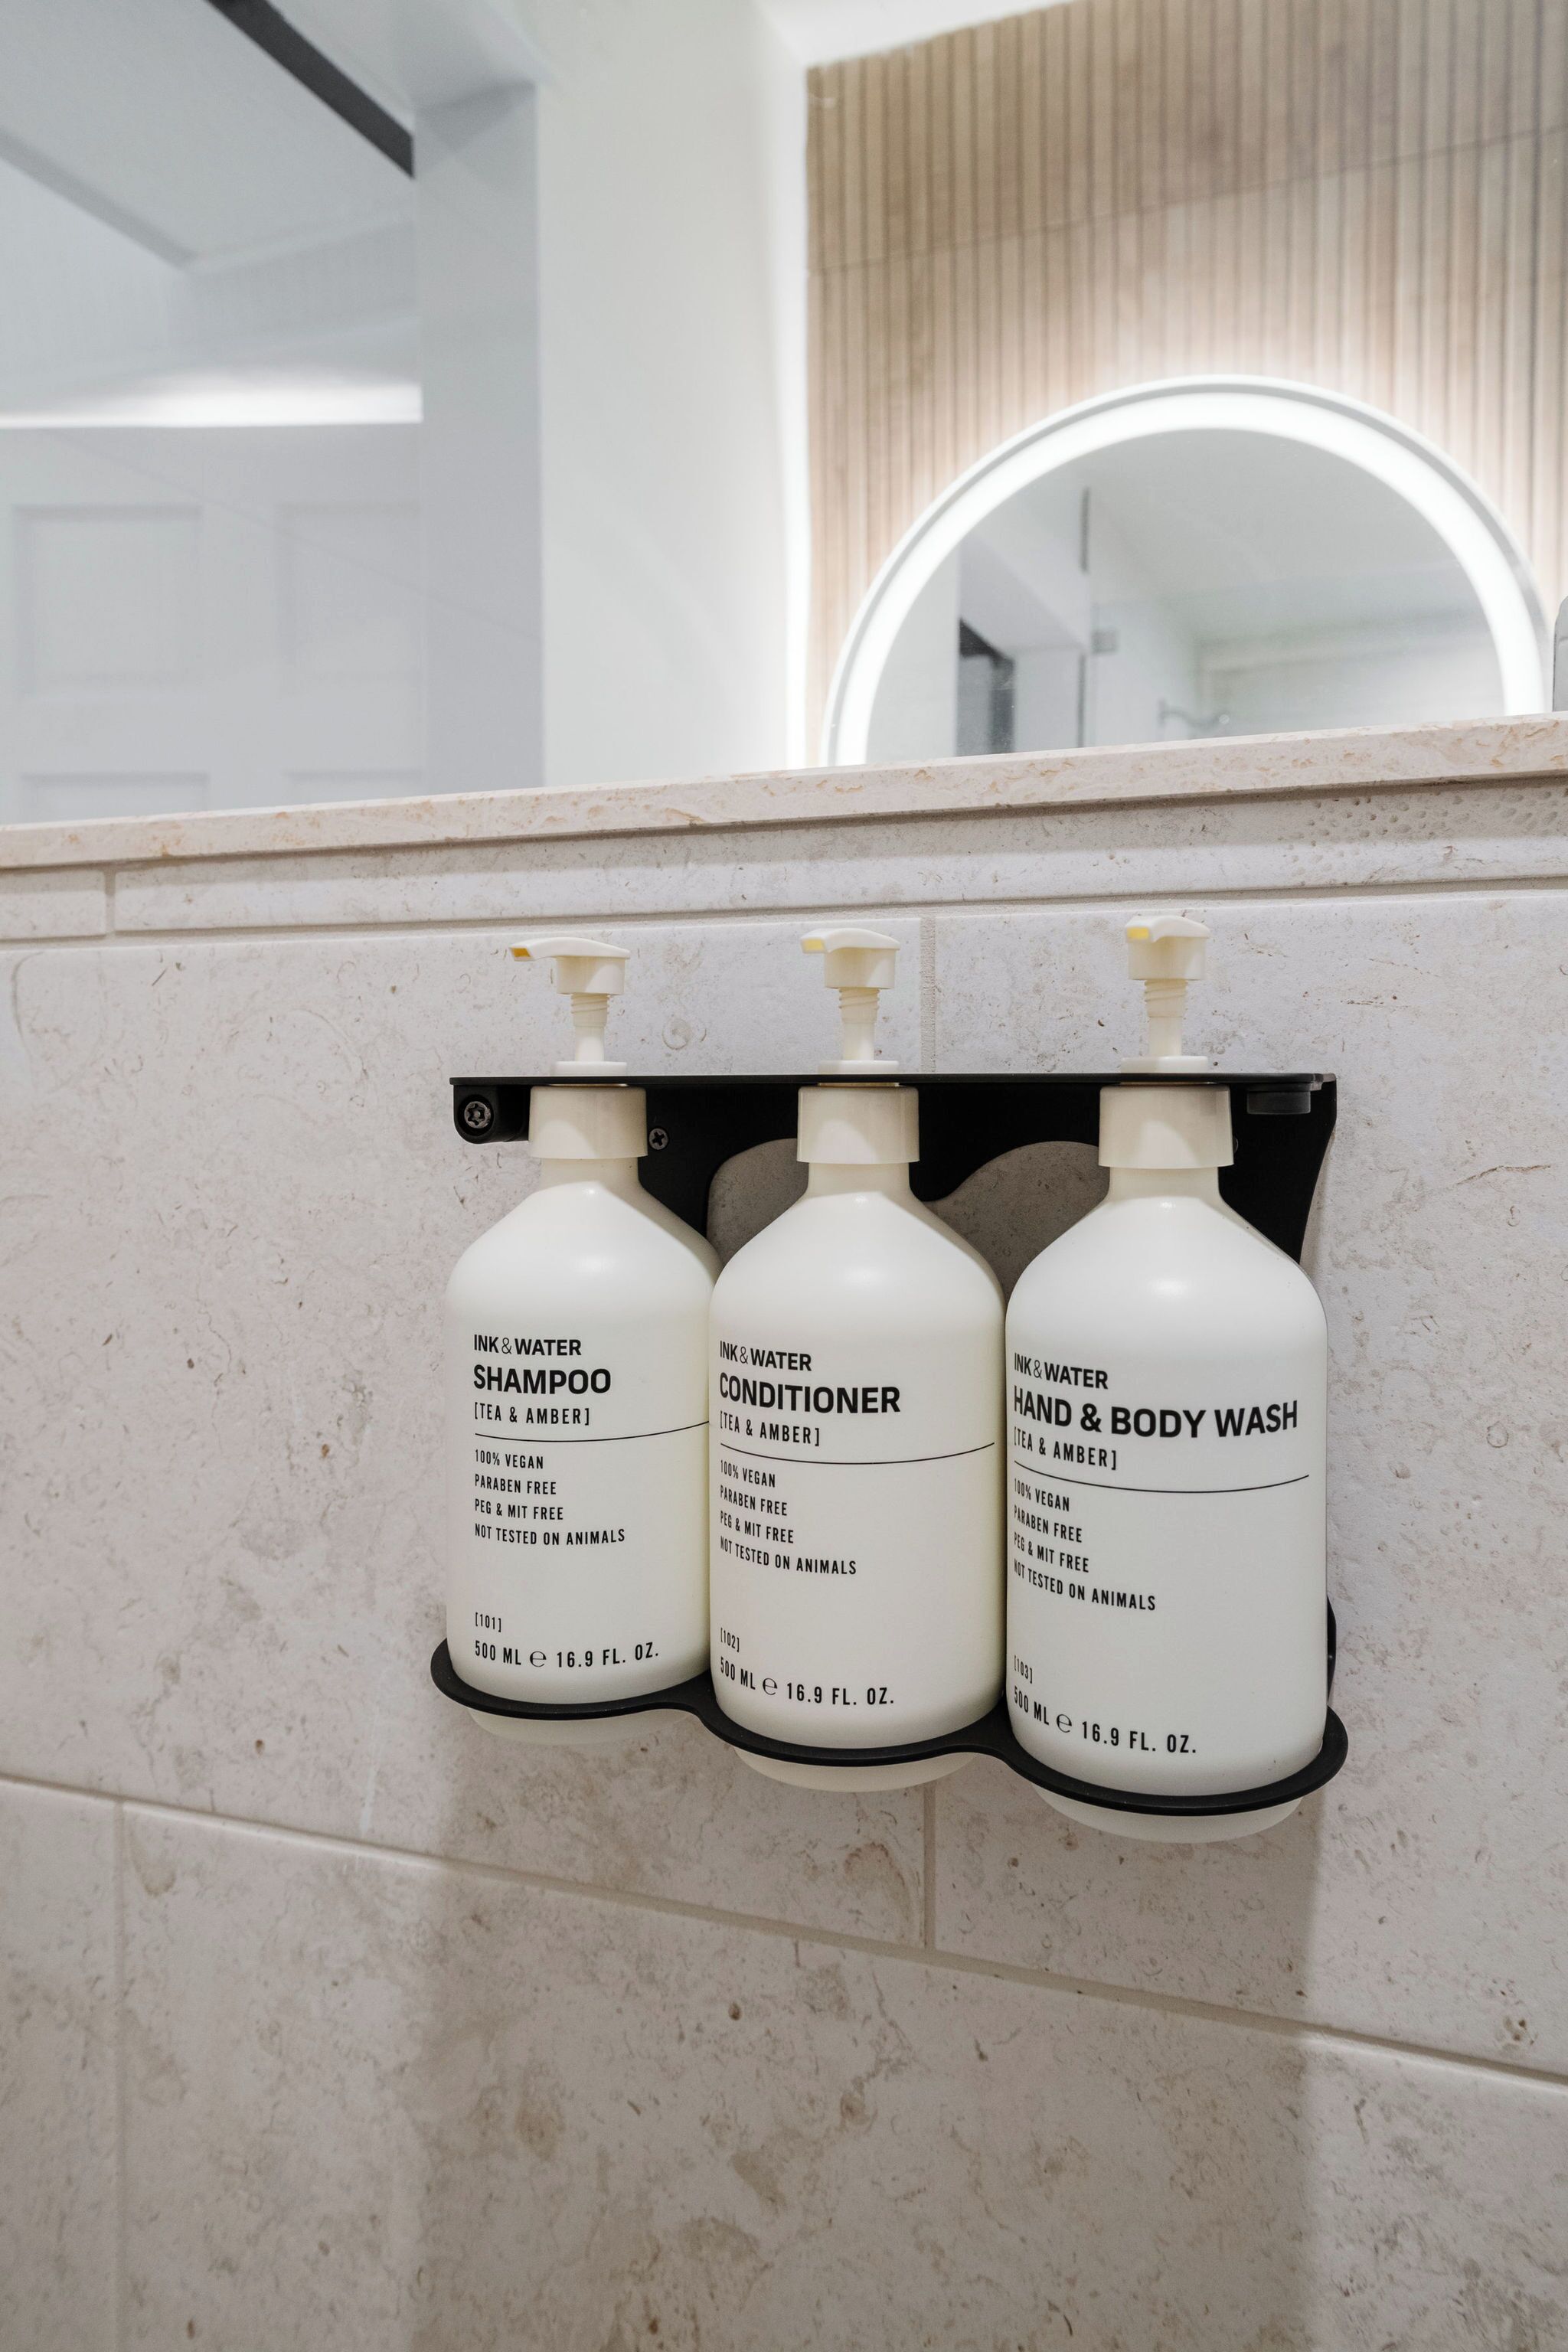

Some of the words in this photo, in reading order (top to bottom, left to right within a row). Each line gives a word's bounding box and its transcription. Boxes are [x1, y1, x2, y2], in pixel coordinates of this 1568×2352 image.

[474, 1364, 611, 1394] SHAMPOO
[720, 1372, 900, 1413] CONDITIONER
[475, 1402, 501, 1421] [TEA
[509, 1406, 517, 1423] &
[526, 1408, 589, 1426] AMBER]
[1014, 1385, 1072, 1426] HAND
[1080, 1403, 1102, 1432] &
[1111, 1406, 1207, 1438] BODY
[1214, 1400, 1297, 1437] WASH
[720, 1410, 740, 1433] [TEA
[746, 1419, 753, 1436] &
[760, 1422, 819, 1446] AMBER]
[475, 1449, 500, 1465] 100%
[505, 1454, 543, 1469] VEGAN
[1014, 1426, 1033, 1452] [TEA
[1039, 1437, 1046, 1455] &
[1054, 1441, 1116, 1471] AMBER]
[475, 1474, 521, 1493] PARABEN
[527, 1481, 556, 1494] FREE
[721, 1460, 738, 1479] 100%
[743, 1468, 775, 1488] VEGAN
[475, 1498, 491, 1514] PEG
[496, 1503, 502, 1516] &
[508, 1504, 528, 1518] MIT
[534, 1507, 564, 1520] FREE
[720, 1485, 755, 1510] PARABEN
[761, 1498, 787, 1516] FREE
[1014, 1478, 1031, 1500] 100%
[1035, 1488, 1069, 1511] VEGAN
[475, 1523, 492, 1539] NOT
[496, 1527, 537, 1544] TESTED
[544, 1532, 559, 1545] ON
[567, 1529, 625, 1545] ANIMALS
[720, 1511, 732, 1528] PEG
[736, 1518, 740, 1531] &
[745, 1521, 761, 1537] MIT
[766, 1526, 793, 1544] FREE
[1014, 1505, 1048, 1534] PARABEN
[1054, 1522, 1082, 1543] FREE
[720, 1536, 732, 1553] NOT
[735, 1544, 769, 1566] TESTED
[775, 1554, 789, 1570] ON
[796, 1557, 856, 1575] ANIMALS
[1014, 1532, 1024, 1551] PEG
[1028, 1541, 1033, 1556] &
[1037, 1545, 1054, 1564] MIT
[1060, 1552, 1089, 1573] FREE
[1014, 1559, 1024, 1579] NOT
[1028, 1568, 1063, 1595] TESTED
[1069, 1583, 1085, 1600] ON
[1092, 1588, 1155, 1611] ANIMALS
[475, 1612, 501, 1632] [101]
[475, 1640, 495, 1661] 500
[503, 1647, 521, 1665] ML
[557, 1651, 593, 1668] 16.9
[603, 1648, 626, 1665] FL.
[635, 1642, 658, 1661] OZ.
[720, 1628, 740, 1652] [102]
[720, 1656, 735, 1681] 500
[740, 1668, 756, 1690] ML
[787, 1682, 822, 1704] 16.9
[832, 1687, 857, 1705] FL.
[867, 1687, 893, 1705] OZ.
[1014, 1655, 1032, 1684] [103]
[1014, 1686, 1028, 1713] 500
[1034, 1701, 1049, 1725] ML
[1082, 1721, 1119, 1746] 16.9
[1130, 1730, 1155, 1751] FL.
[1167, 1734, 1196, 1753] OZ.
